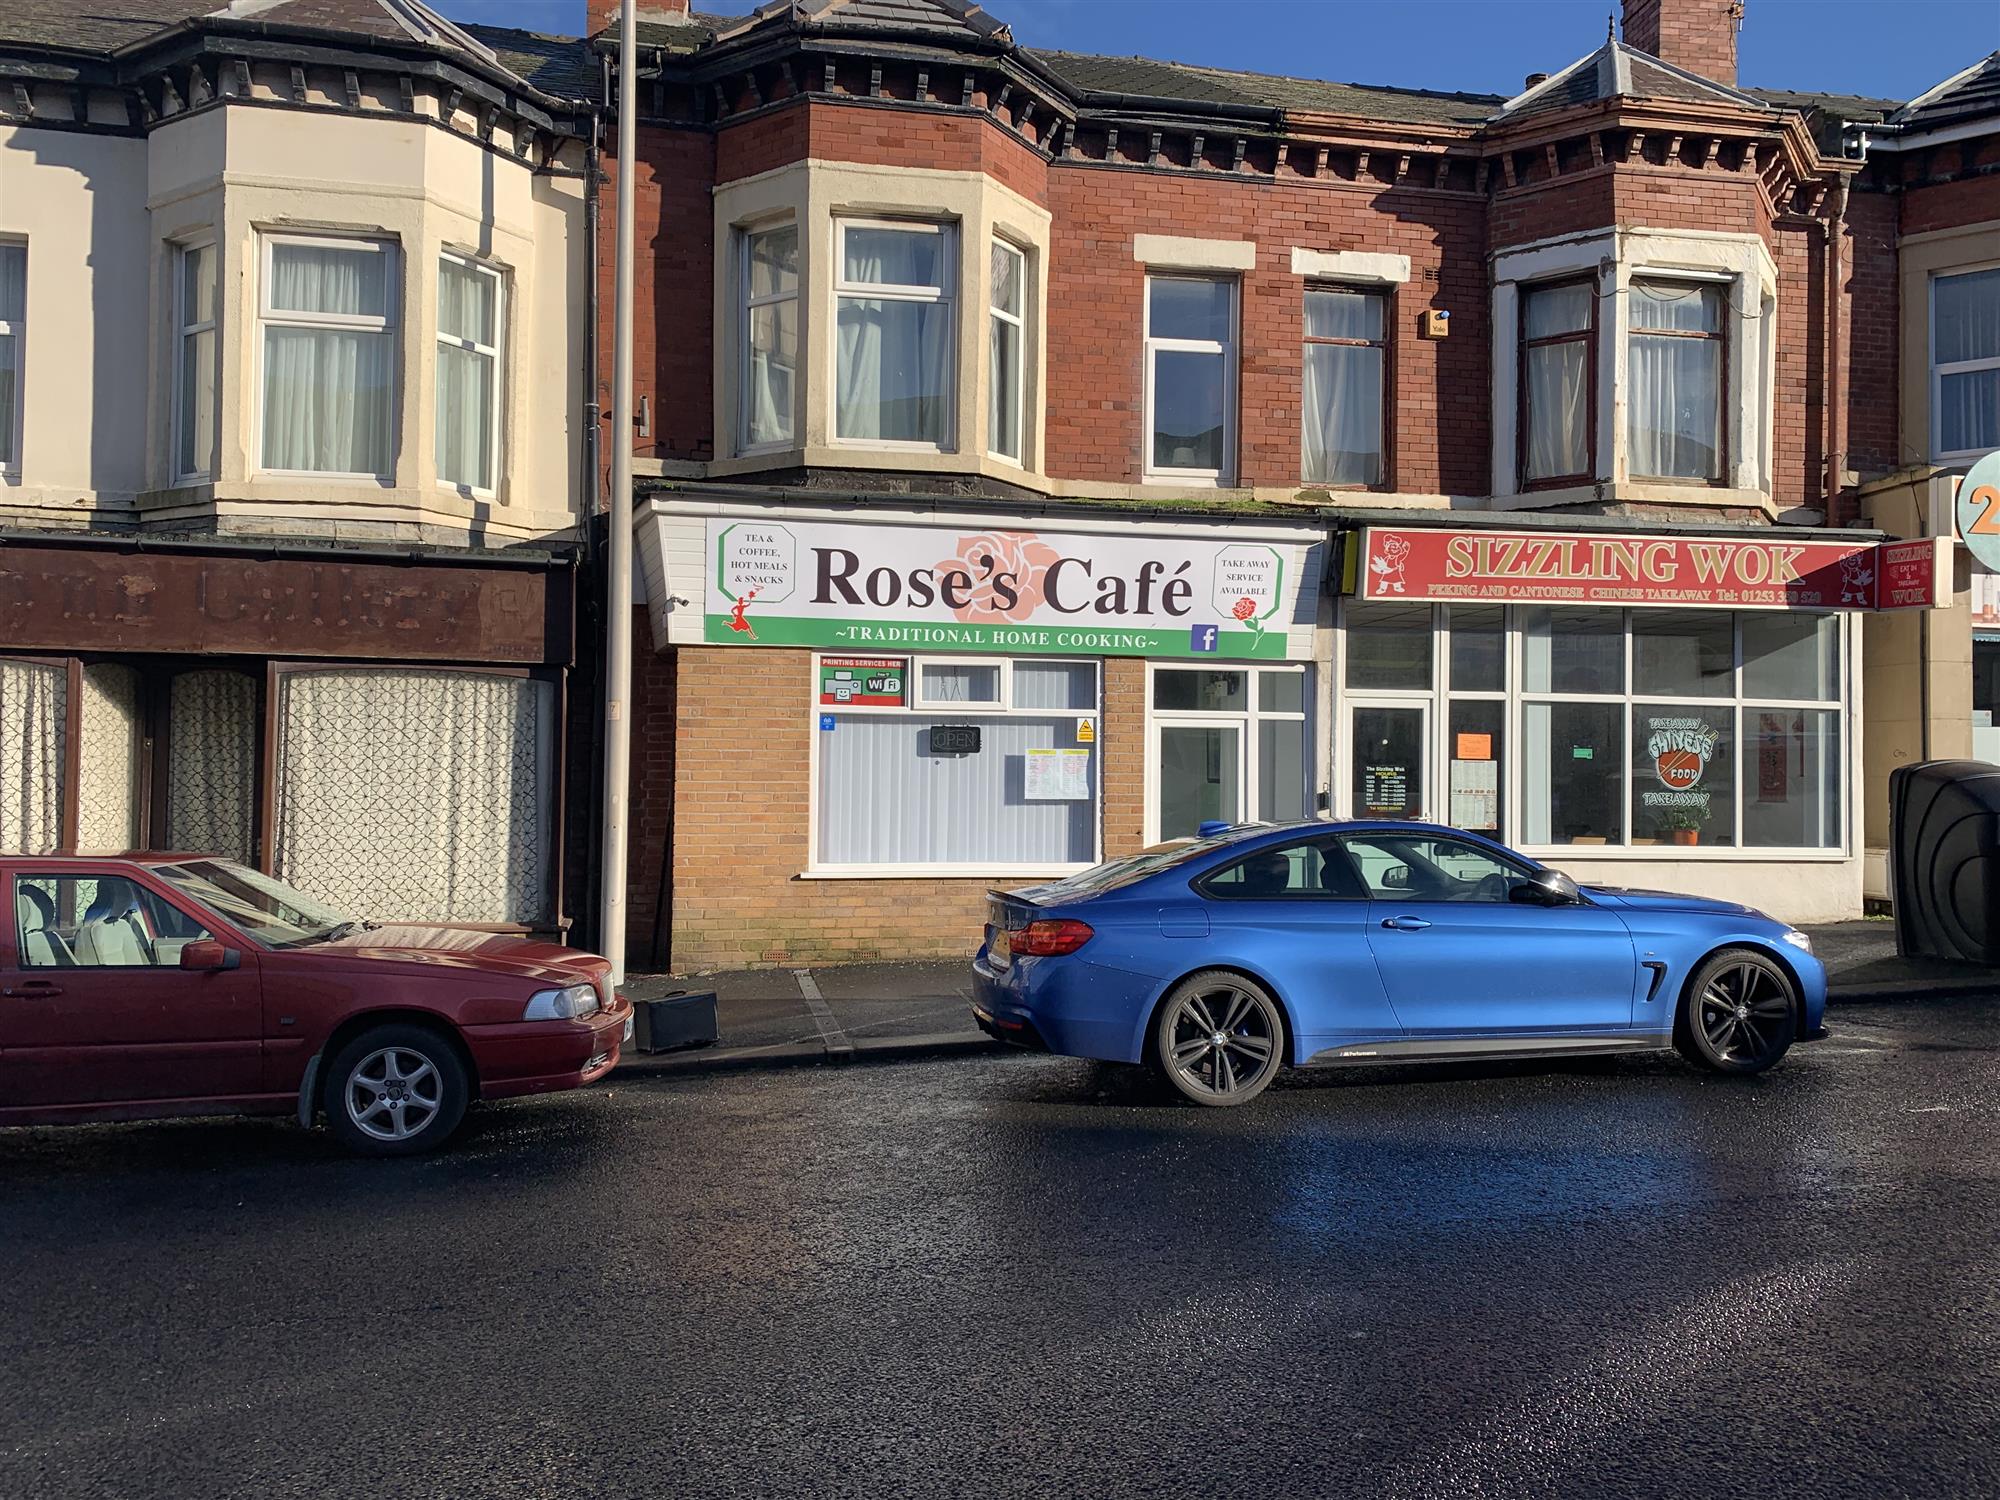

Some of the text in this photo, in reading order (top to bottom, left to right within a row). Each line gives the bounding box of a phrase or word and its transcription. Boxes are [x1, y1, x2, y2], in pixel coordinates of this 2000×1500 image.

[745, 534, 774, 543] TEA &
[739, 548, 781, 558] COFFEE,
[1886, 545, 1933, 563] SIZZLING
[731, 561, 788, 571] HOT MEALS
[1221, 560, 1270, 569] TAKE AWAY
[1446, 536, 1806, 586] SIZZLING WOK
[734, 575, 784, 584] & SNACKS
[809, 547, 1193, 617] Rose's Café
[1226, 573, 1264, 582] SERVICE
[1220, 587, 1267, 596] AVAILABLE
[1427, 584, 1478, 597] PEKING
[1479, 585, 1507, 597] AND
[1509, 586, 1585, 599] CANTONESE
[1589, 587, 1643, 600] CHINESE
[1645, 588, 1711, 601] TAKEAWAY
[1716, 589, 1738, 602] Tel:
[1741, 590, 1775, 602] 01253
[1891, 588, 1926, 605] WOK
[992, 631, 1049, 646] HOME
[935, 731, 976, 748] OPEN
[1648, 729, 1714, 762] CHINESE
[1671, 769, 1697, 780] FOOD
